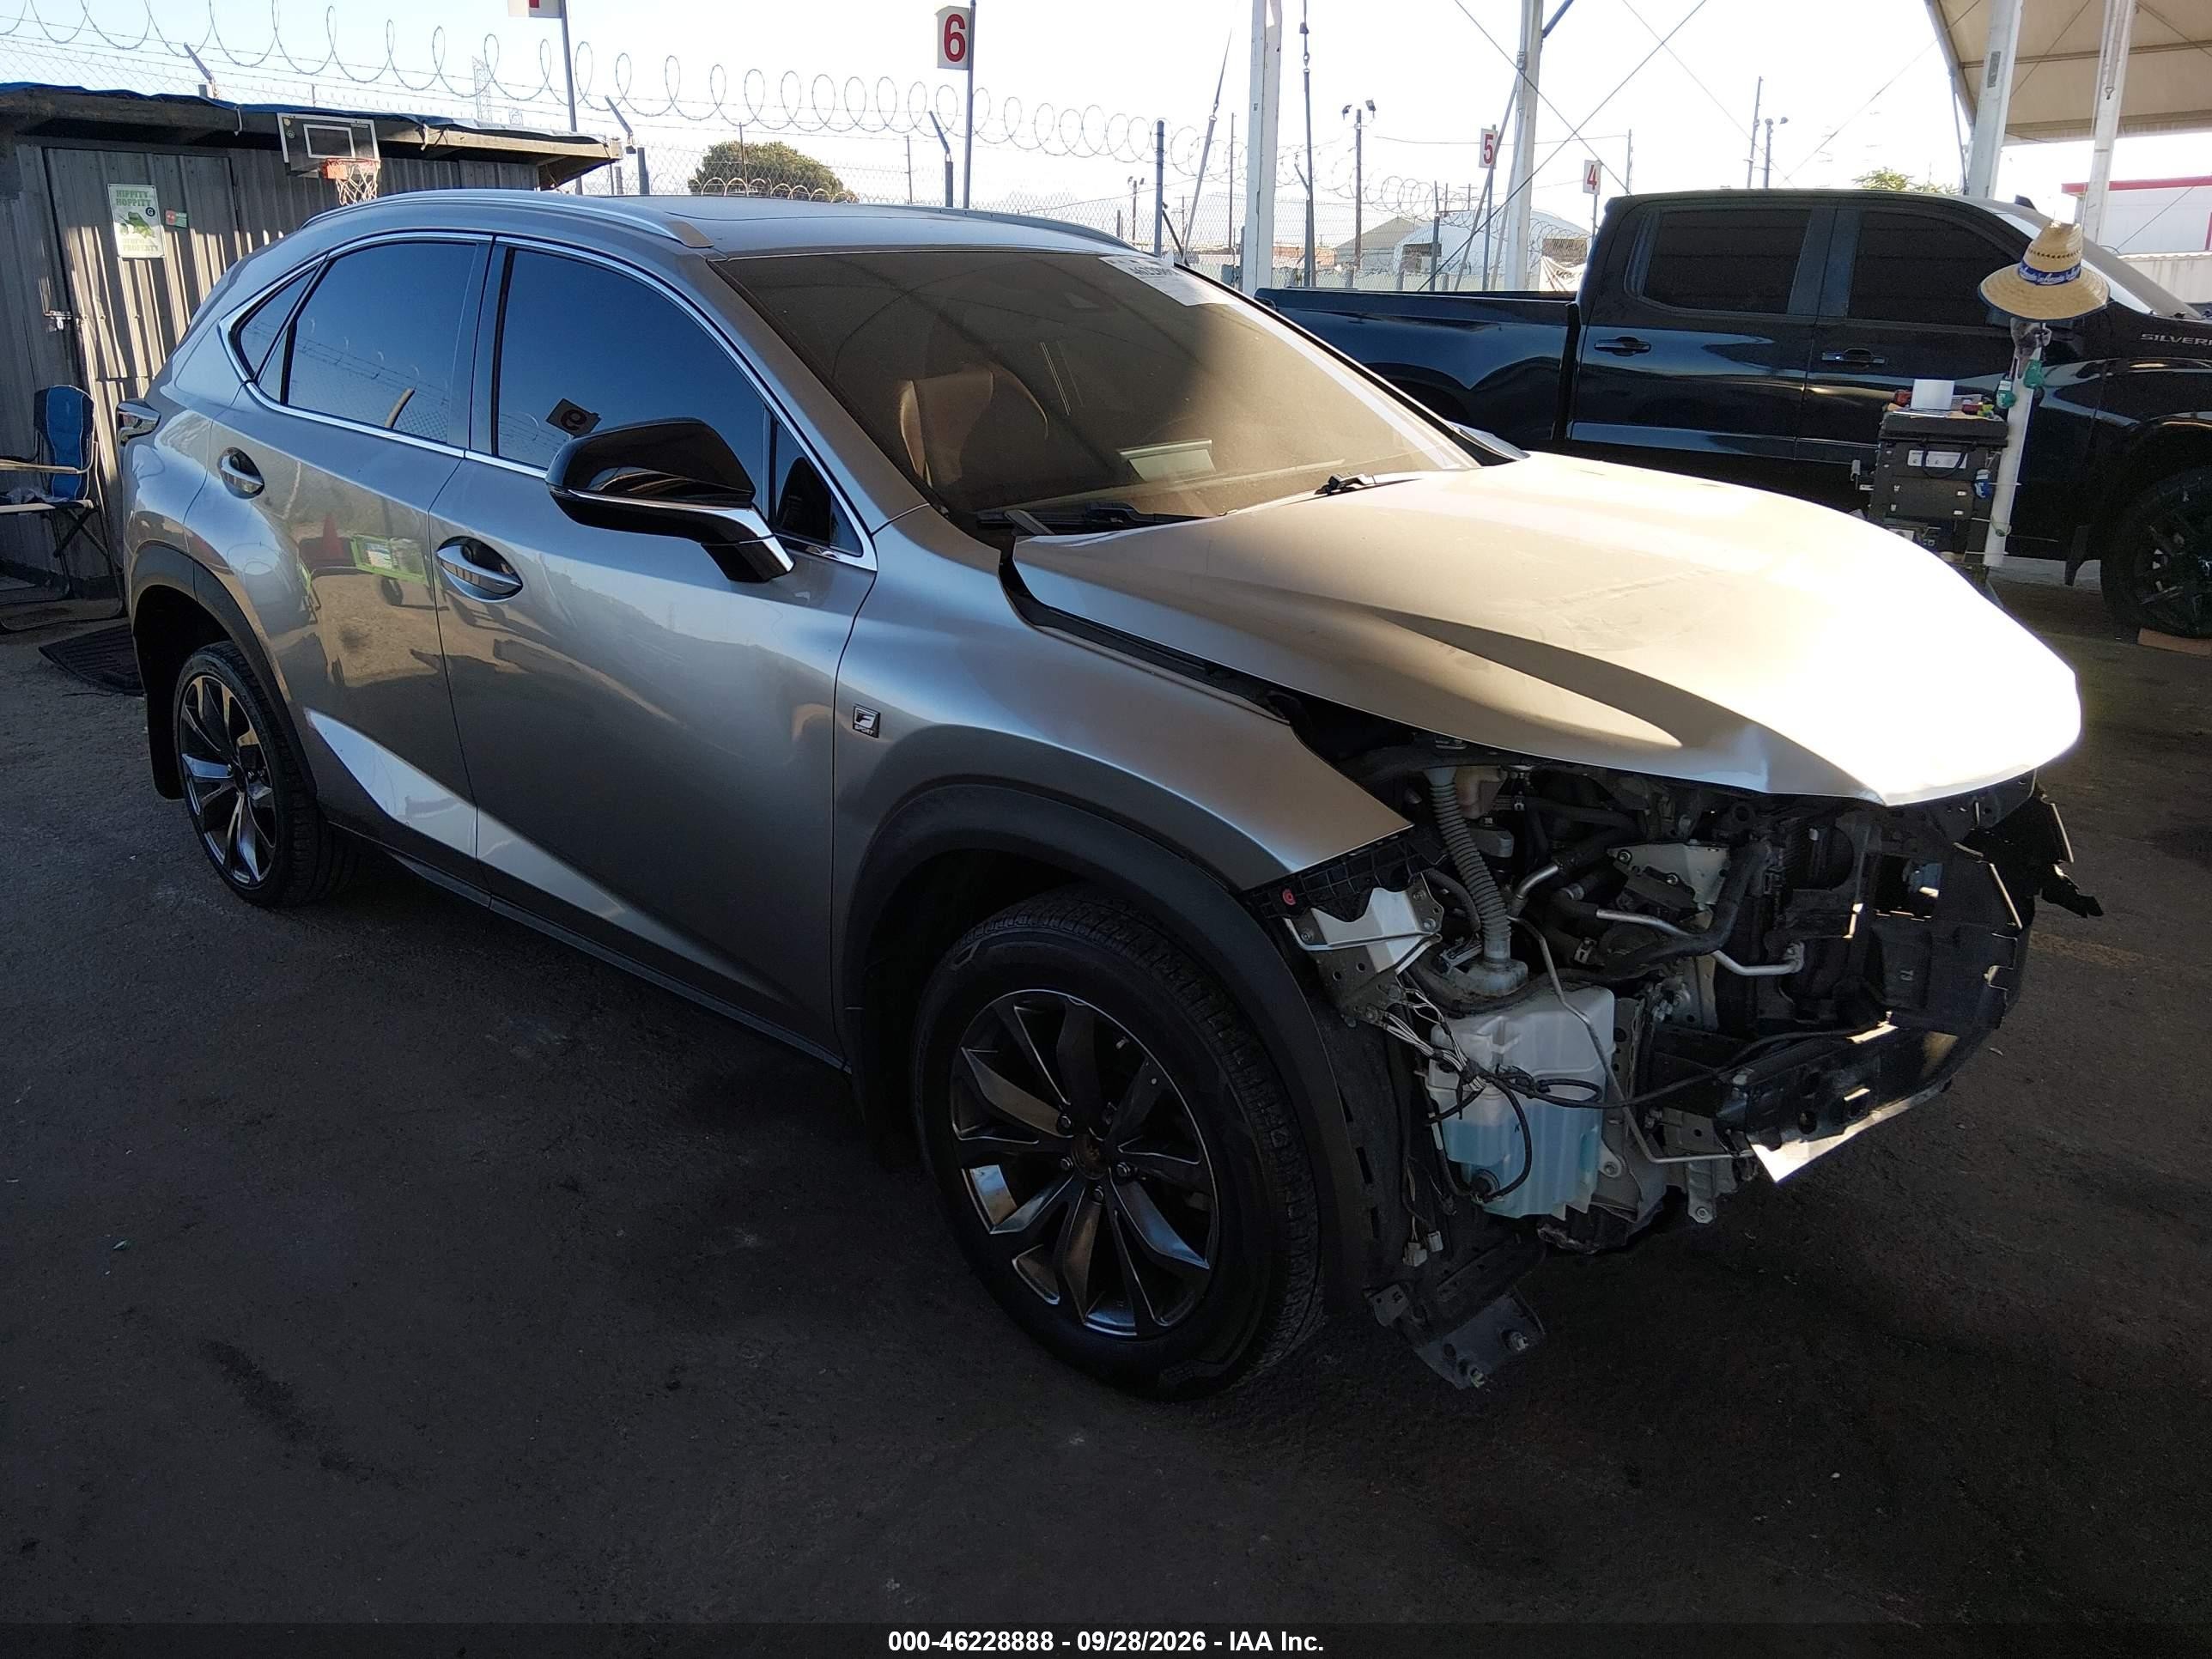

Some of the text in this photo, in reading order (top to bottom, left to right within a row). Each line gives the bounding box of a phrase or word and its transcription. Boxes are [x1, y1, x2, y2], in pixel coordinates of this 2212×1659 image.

[944, 13, 966, 63] 6
[1483, 133, 1494, 165] 5
[1586, 164, 1597, 191] 4
[116, 190, 149, 198] HIPPITY
